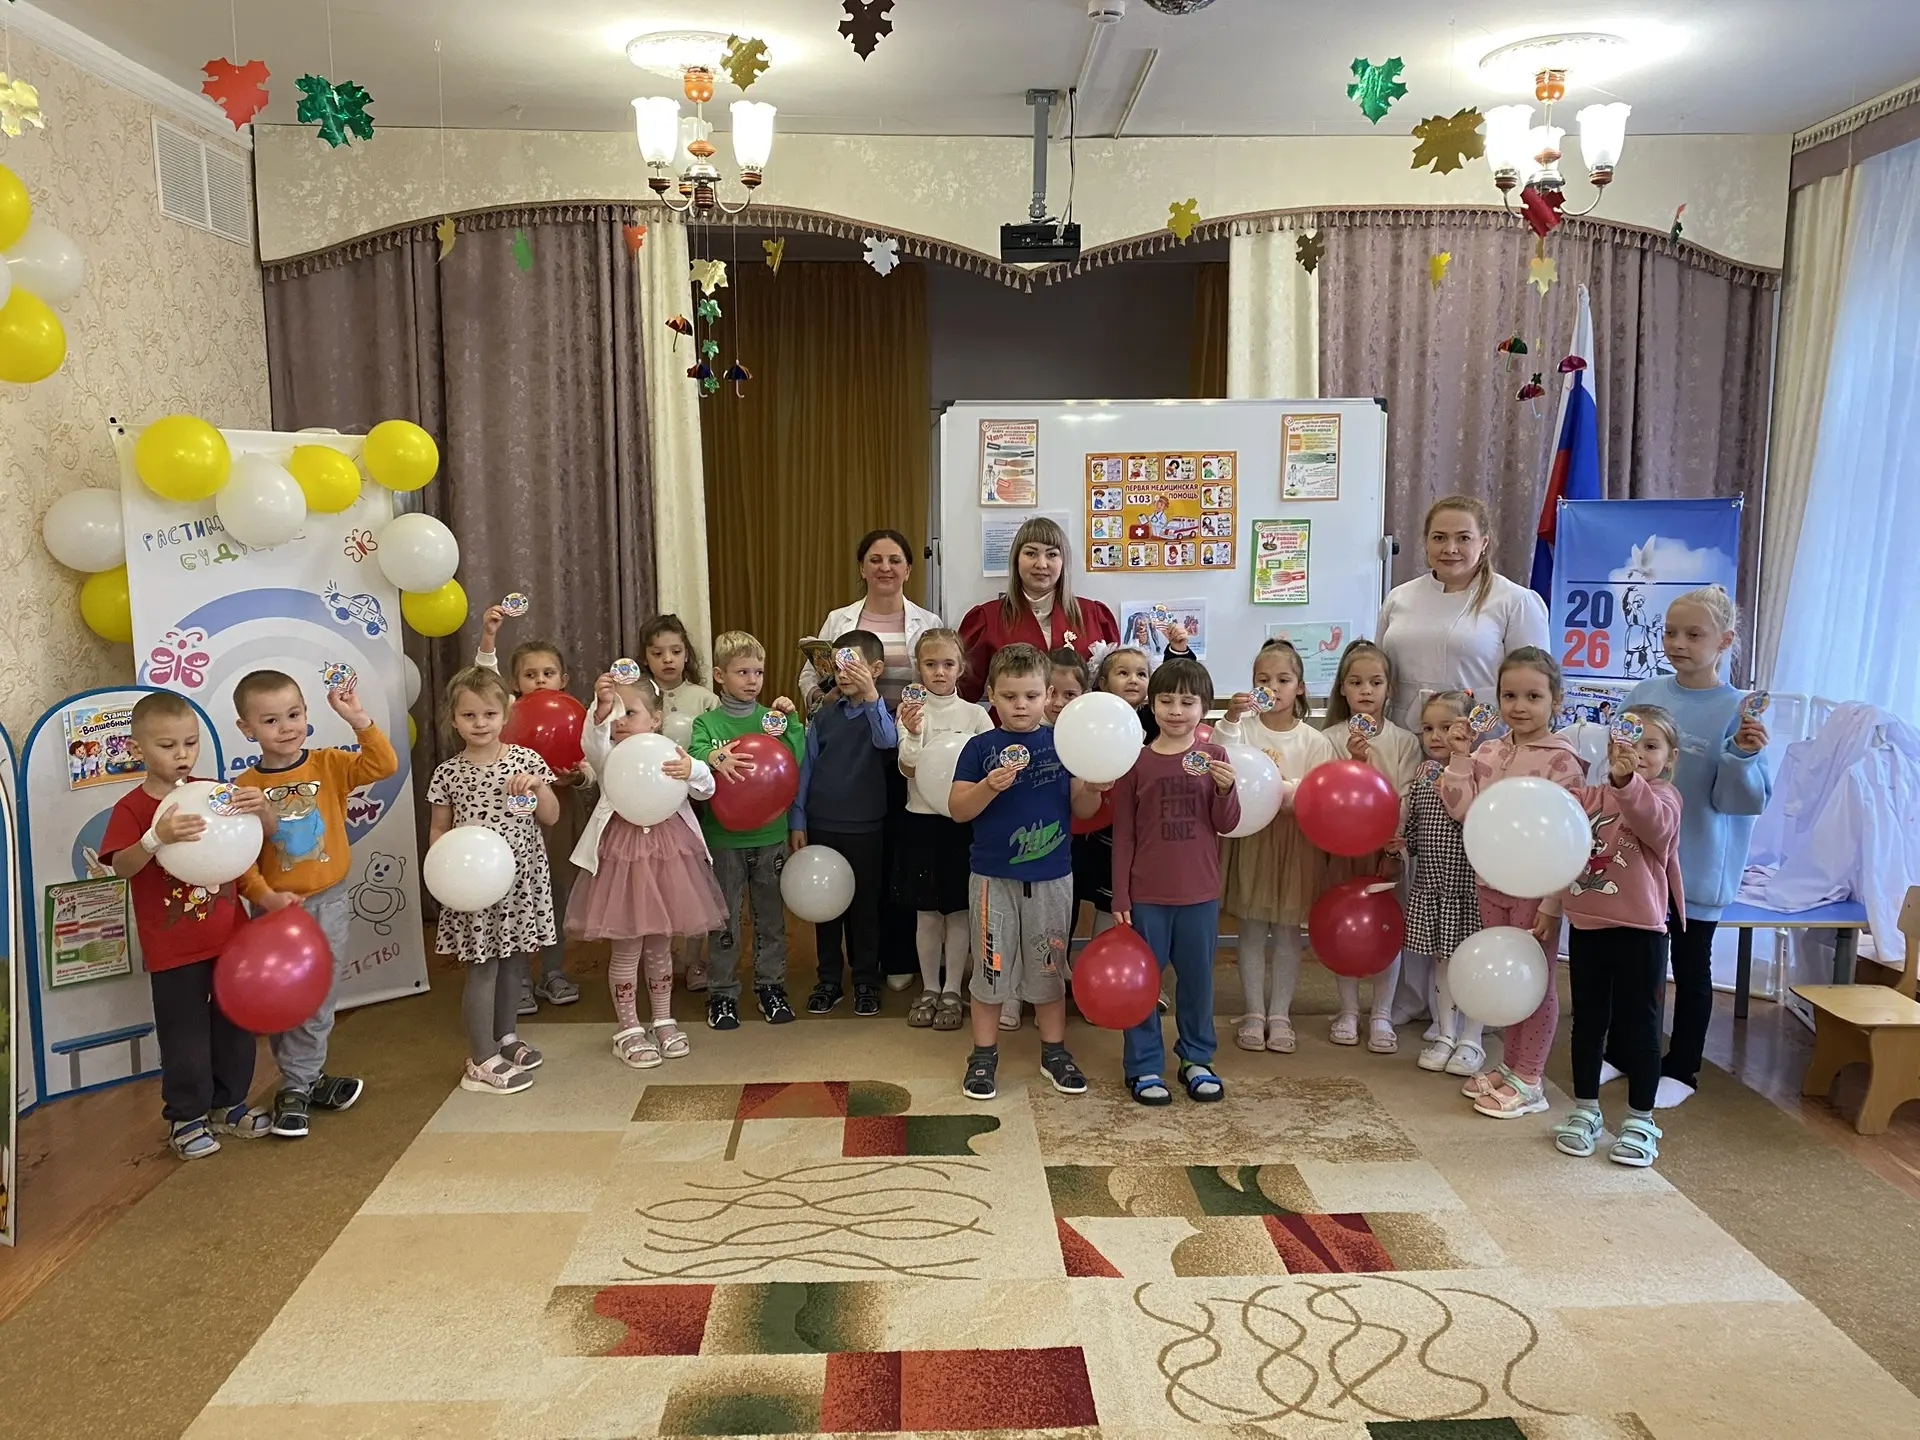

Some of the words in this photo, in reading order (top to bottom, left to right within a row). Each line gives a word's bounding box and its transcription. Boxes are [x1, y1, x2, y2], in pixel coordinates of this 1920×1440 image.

[1125, 484, 1150, 492] ПЕРВАЯ
[1151, 483, 1199, 492] МЕДИЦИНСКАЯ
[1133, 494, 1151, 504] 103
[142, 515, 225, 552] РАСТИМ
[1564, 589, 1614, 630] 20
[1561, 629, 1610, 670] 26
[102, 709, 133, 721] Станци
[1158, 776, 1197, 797] THE
[1159, 799, 1197, 819] FUN
[1161, 820, 1197, 841] ONE
[57, 895, 77, 906] Как
[340, 942, 400, 982] ЕТСТВО
